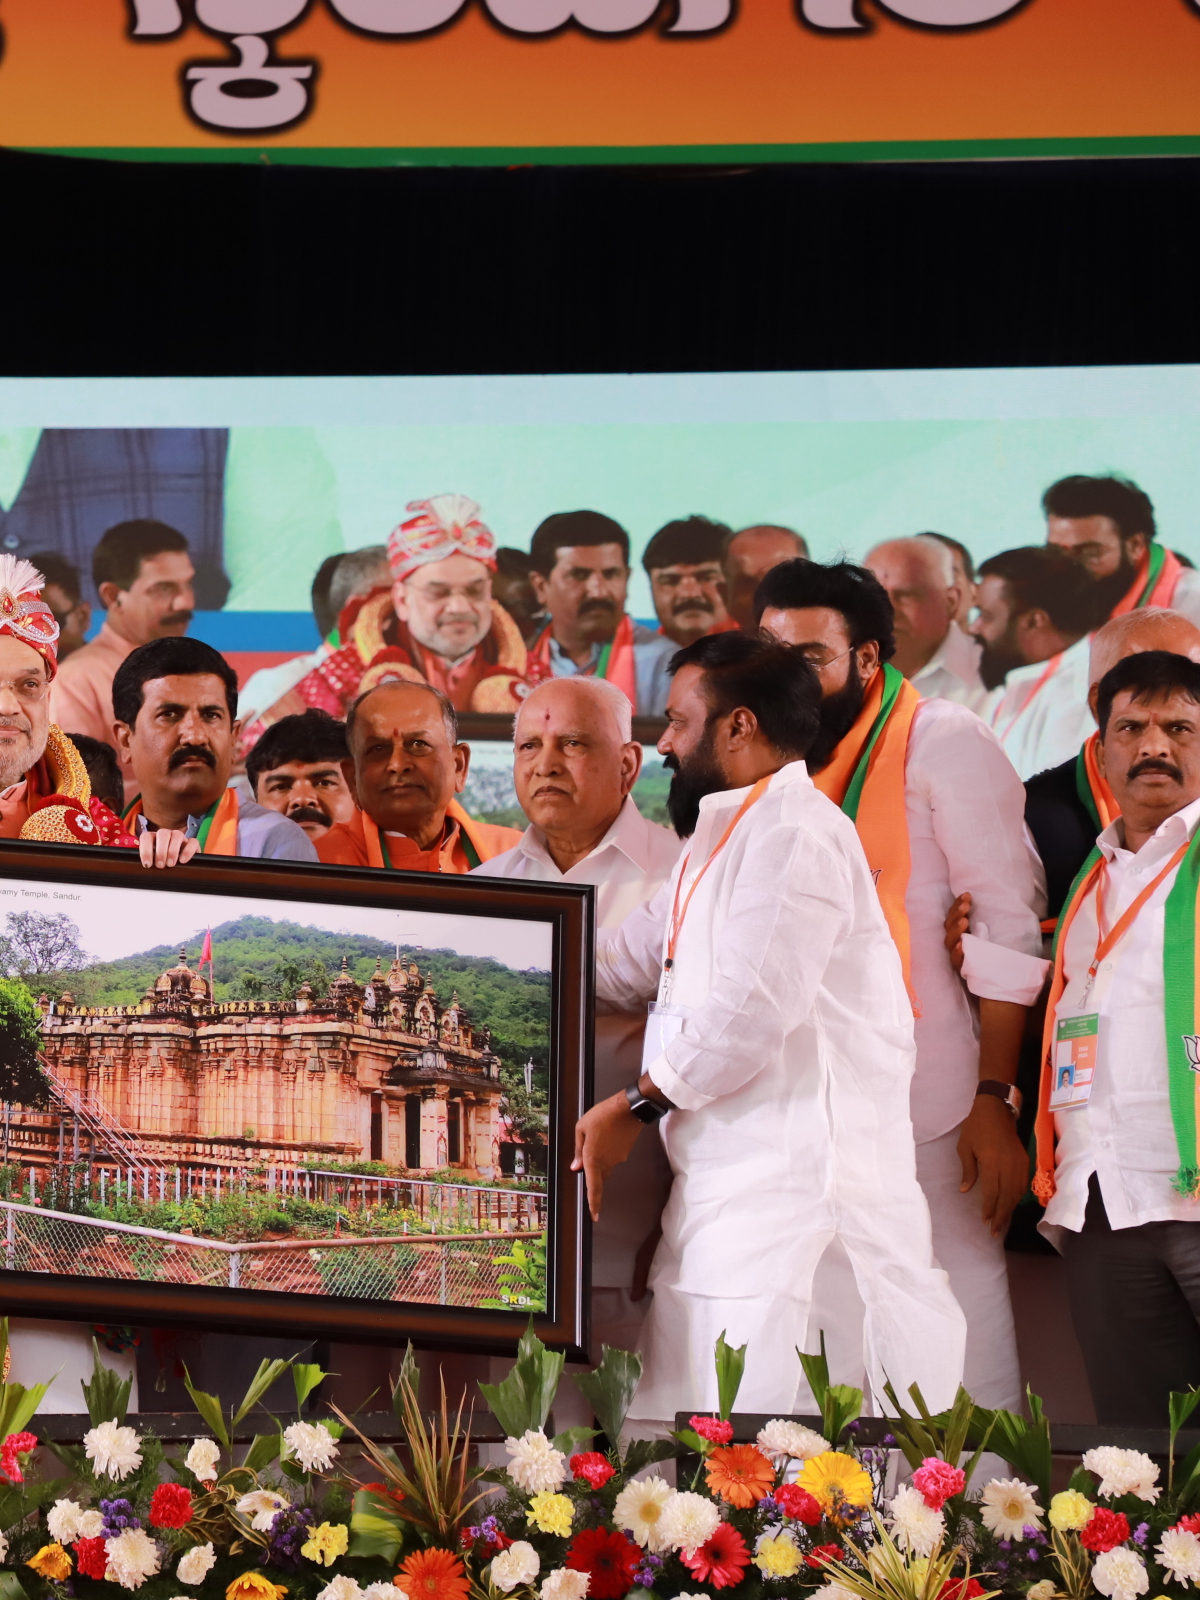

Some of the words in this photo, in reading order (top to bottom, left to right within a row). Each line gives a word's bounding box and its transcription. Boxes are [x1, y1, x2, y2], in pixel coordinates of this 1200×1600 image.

[20, 889, 50, 899] Temple,
[52, 892, 83, 901] Sandur.
[501, 1294, 534, 1305] SRDL
